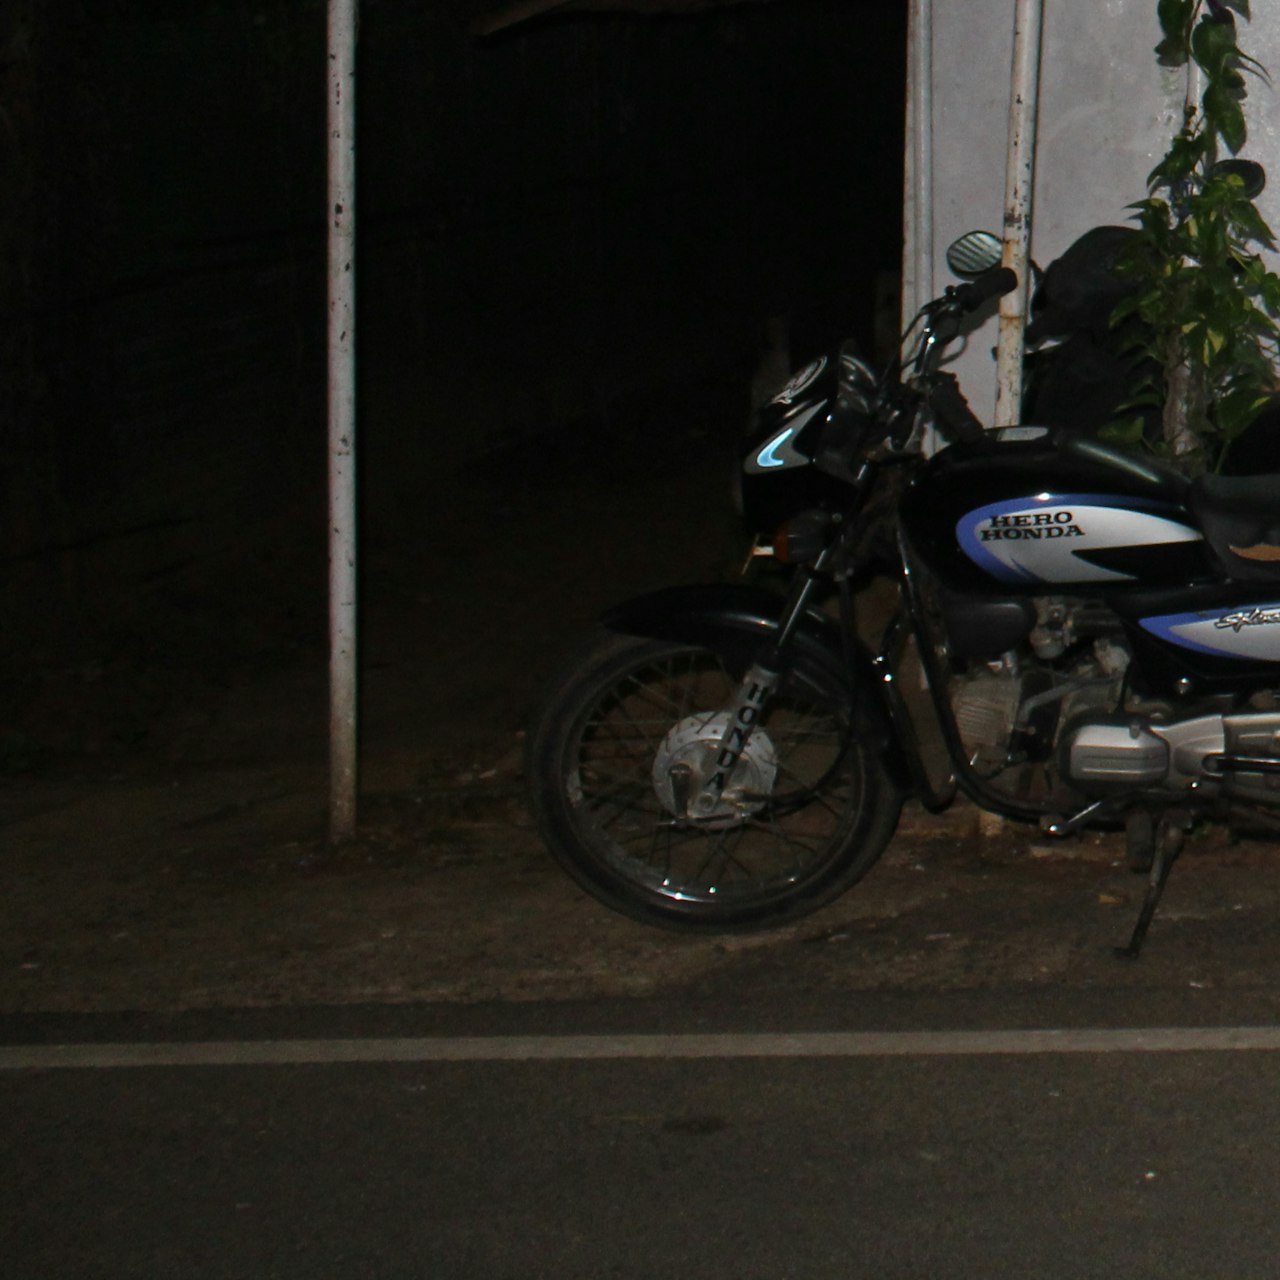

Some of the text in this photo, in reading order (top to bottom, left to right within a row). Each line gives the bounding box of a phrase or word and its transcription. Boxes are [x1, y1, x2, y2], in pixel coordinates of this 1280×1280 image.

[989, 510, 1073, 529] HERO
[979, 524, 1086, 543] HONDA
[705, 683, 770, 790] HONDA
